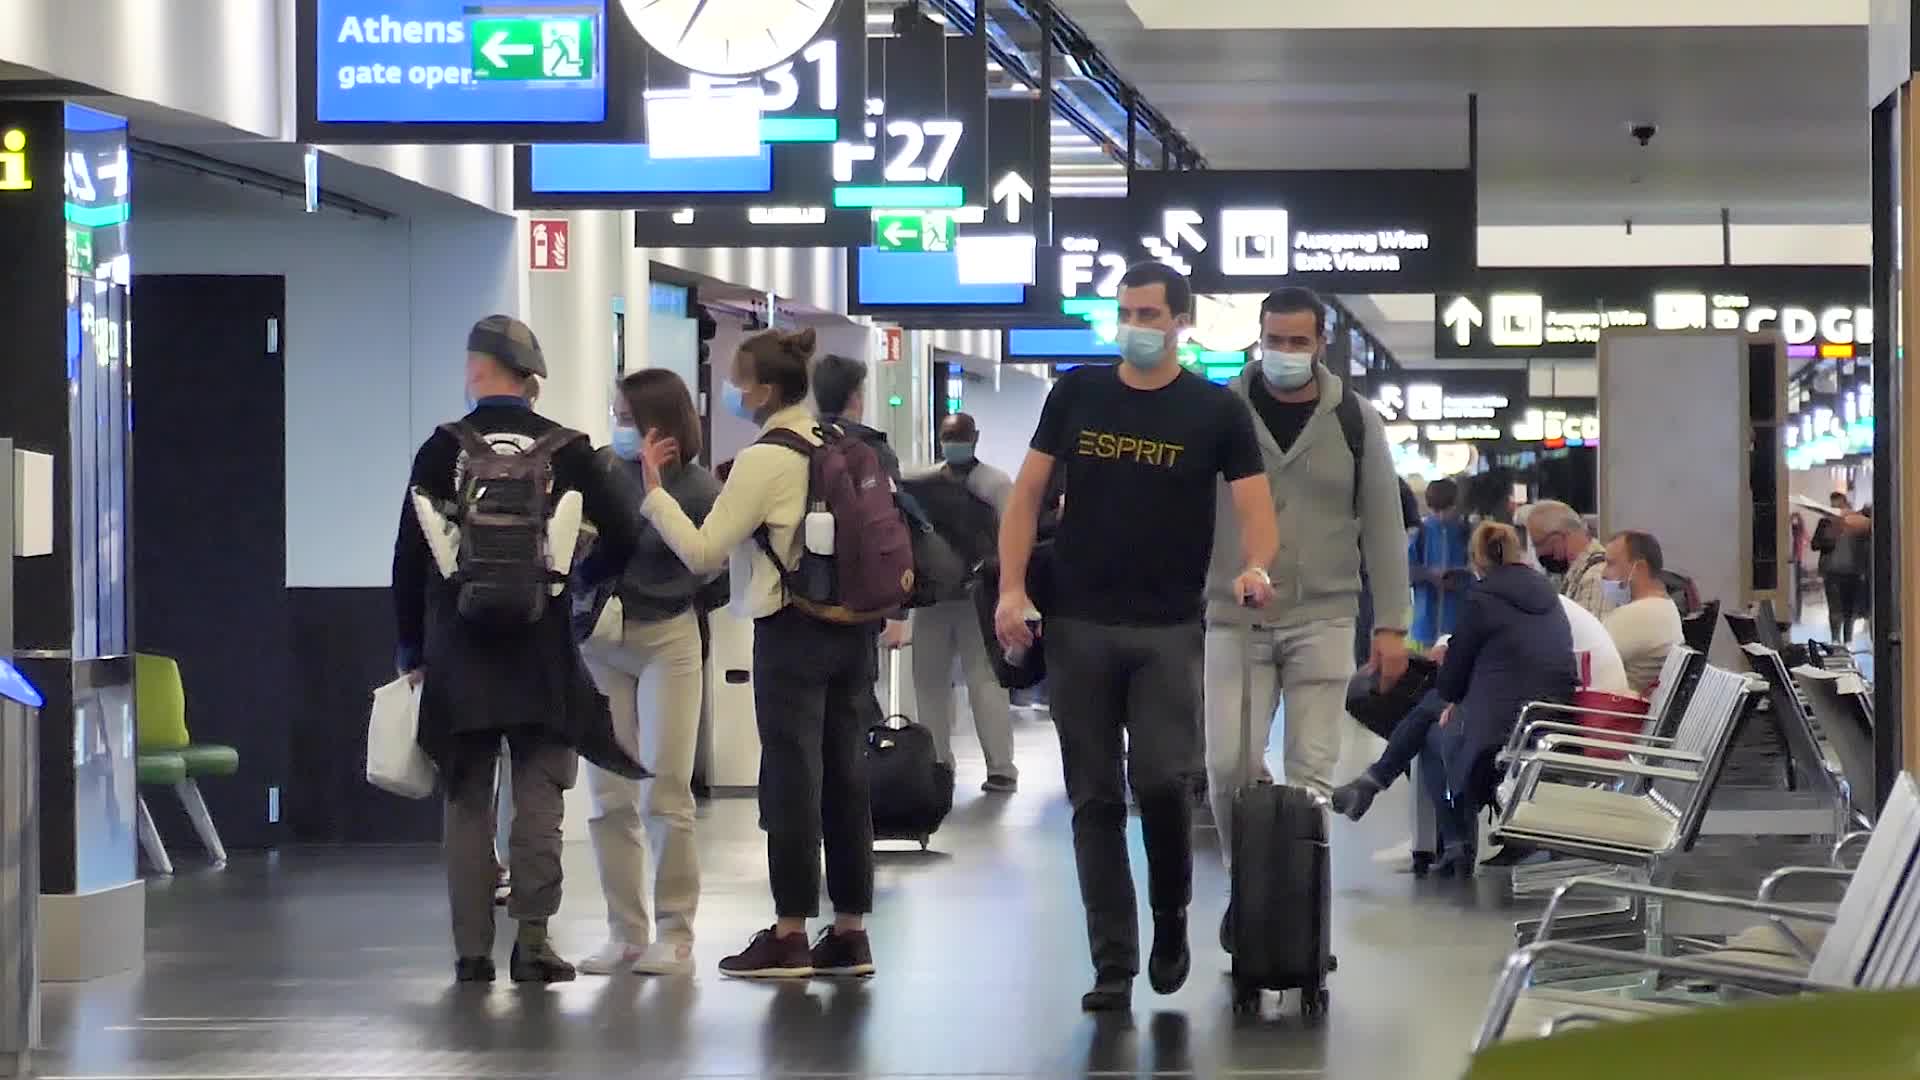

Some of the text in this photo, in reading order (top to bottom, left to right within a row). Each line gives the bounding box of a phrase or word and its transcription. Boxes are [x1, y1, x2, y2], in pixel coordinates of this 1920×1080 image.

[337, 14, 465, 44] Athens
[338, 63, 402, 89] gate
[1078, 429, 1185, 468] ESPRIT
